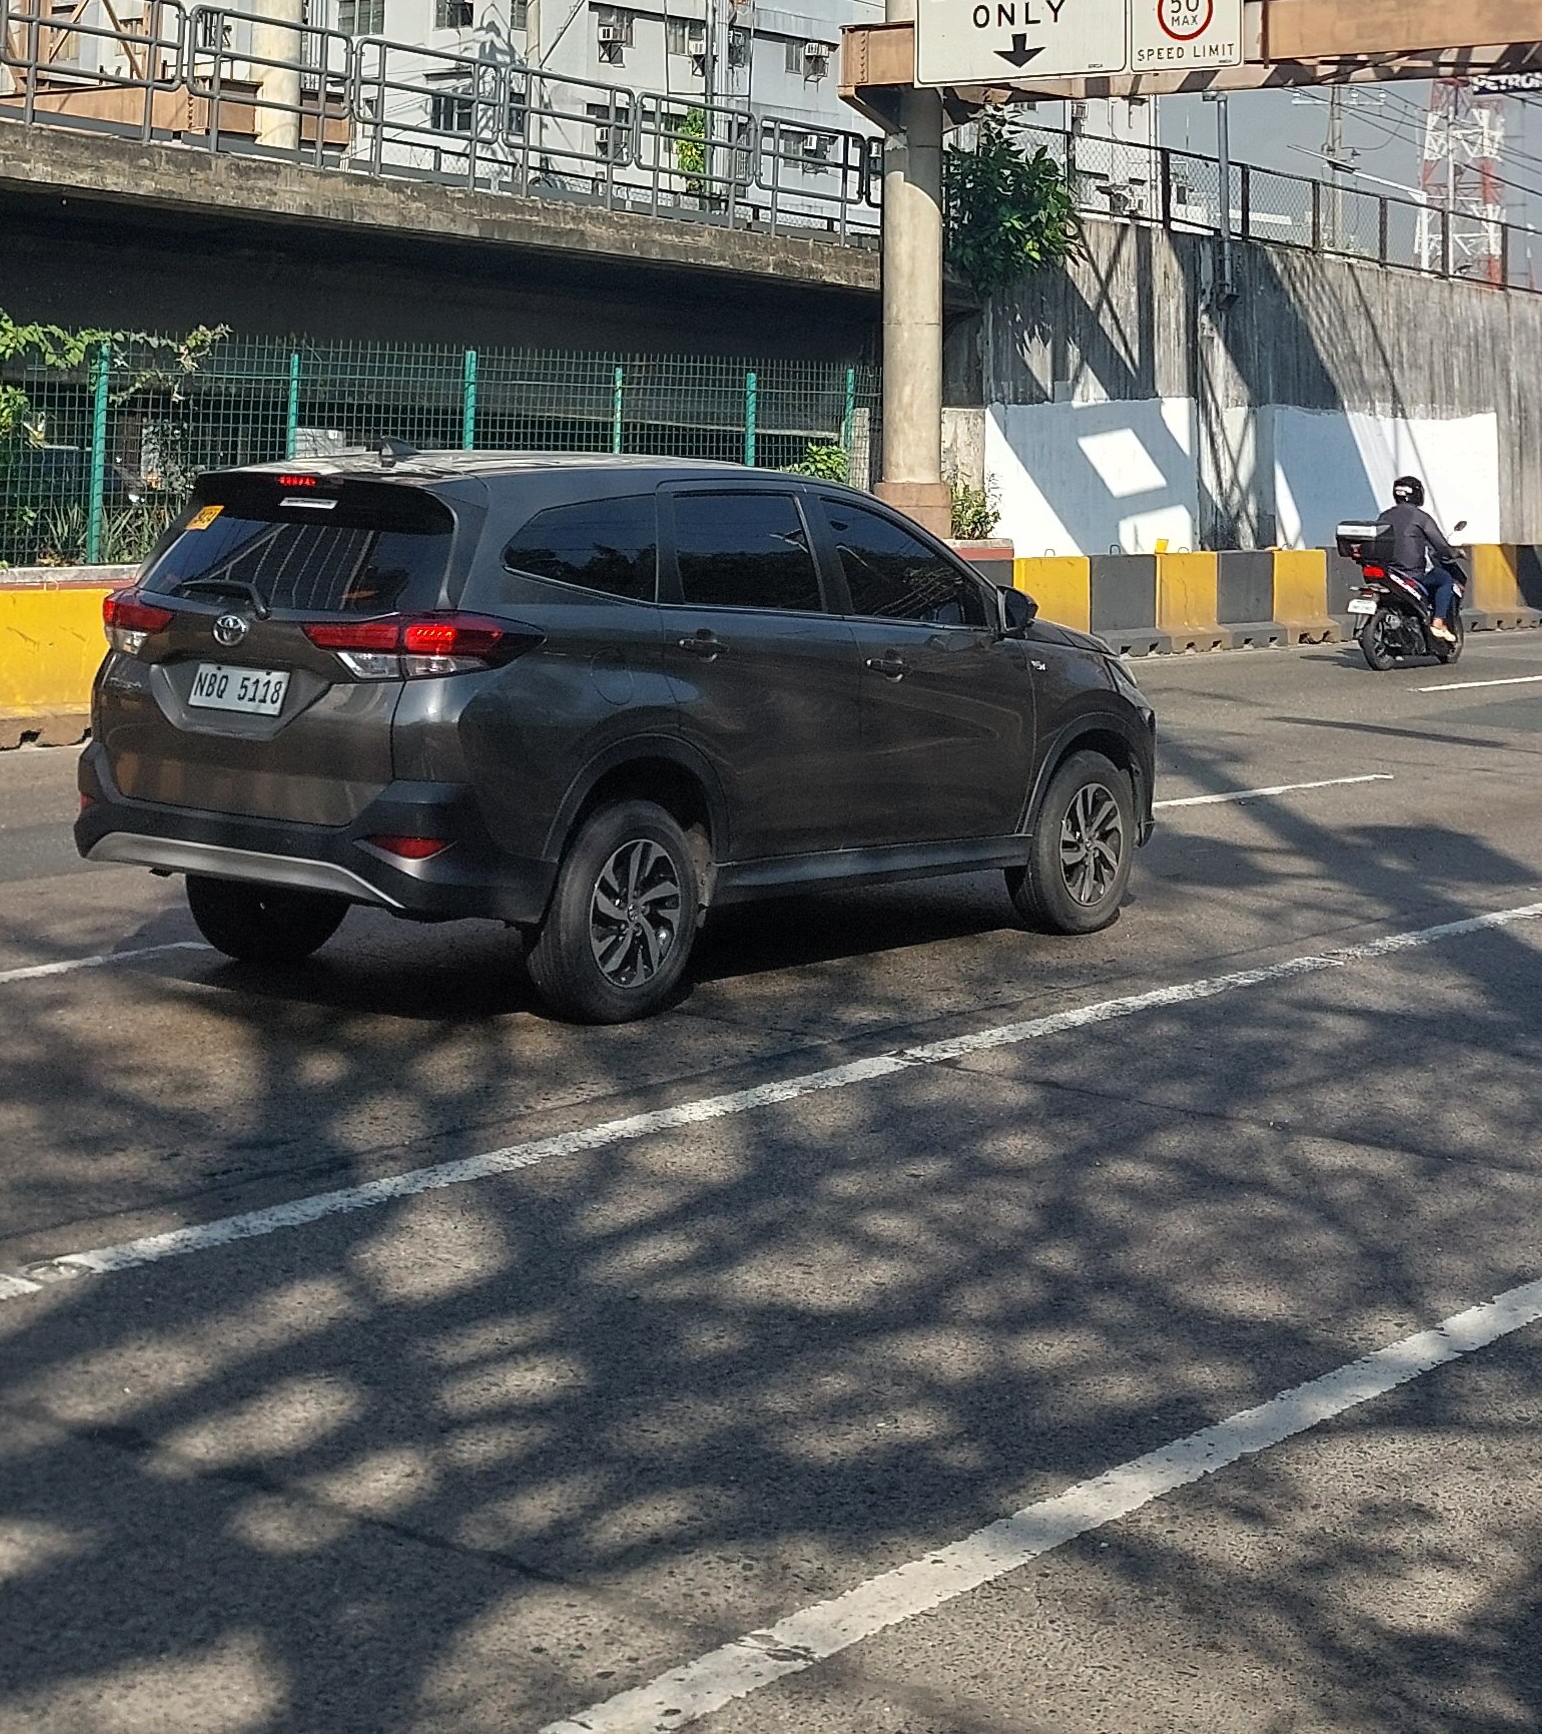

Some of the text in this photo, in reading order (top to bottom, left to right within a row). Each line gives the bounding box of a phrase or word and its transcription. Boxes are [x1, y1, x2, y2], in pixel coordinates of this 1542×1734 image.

[973, 0, 1065, 28] ONLY
[1171, 15, 1198, 26] MAX
[1137, 44, 1234, 61] SPEED LIMIT
[194, 672, 284, 705] NBQ 5118
